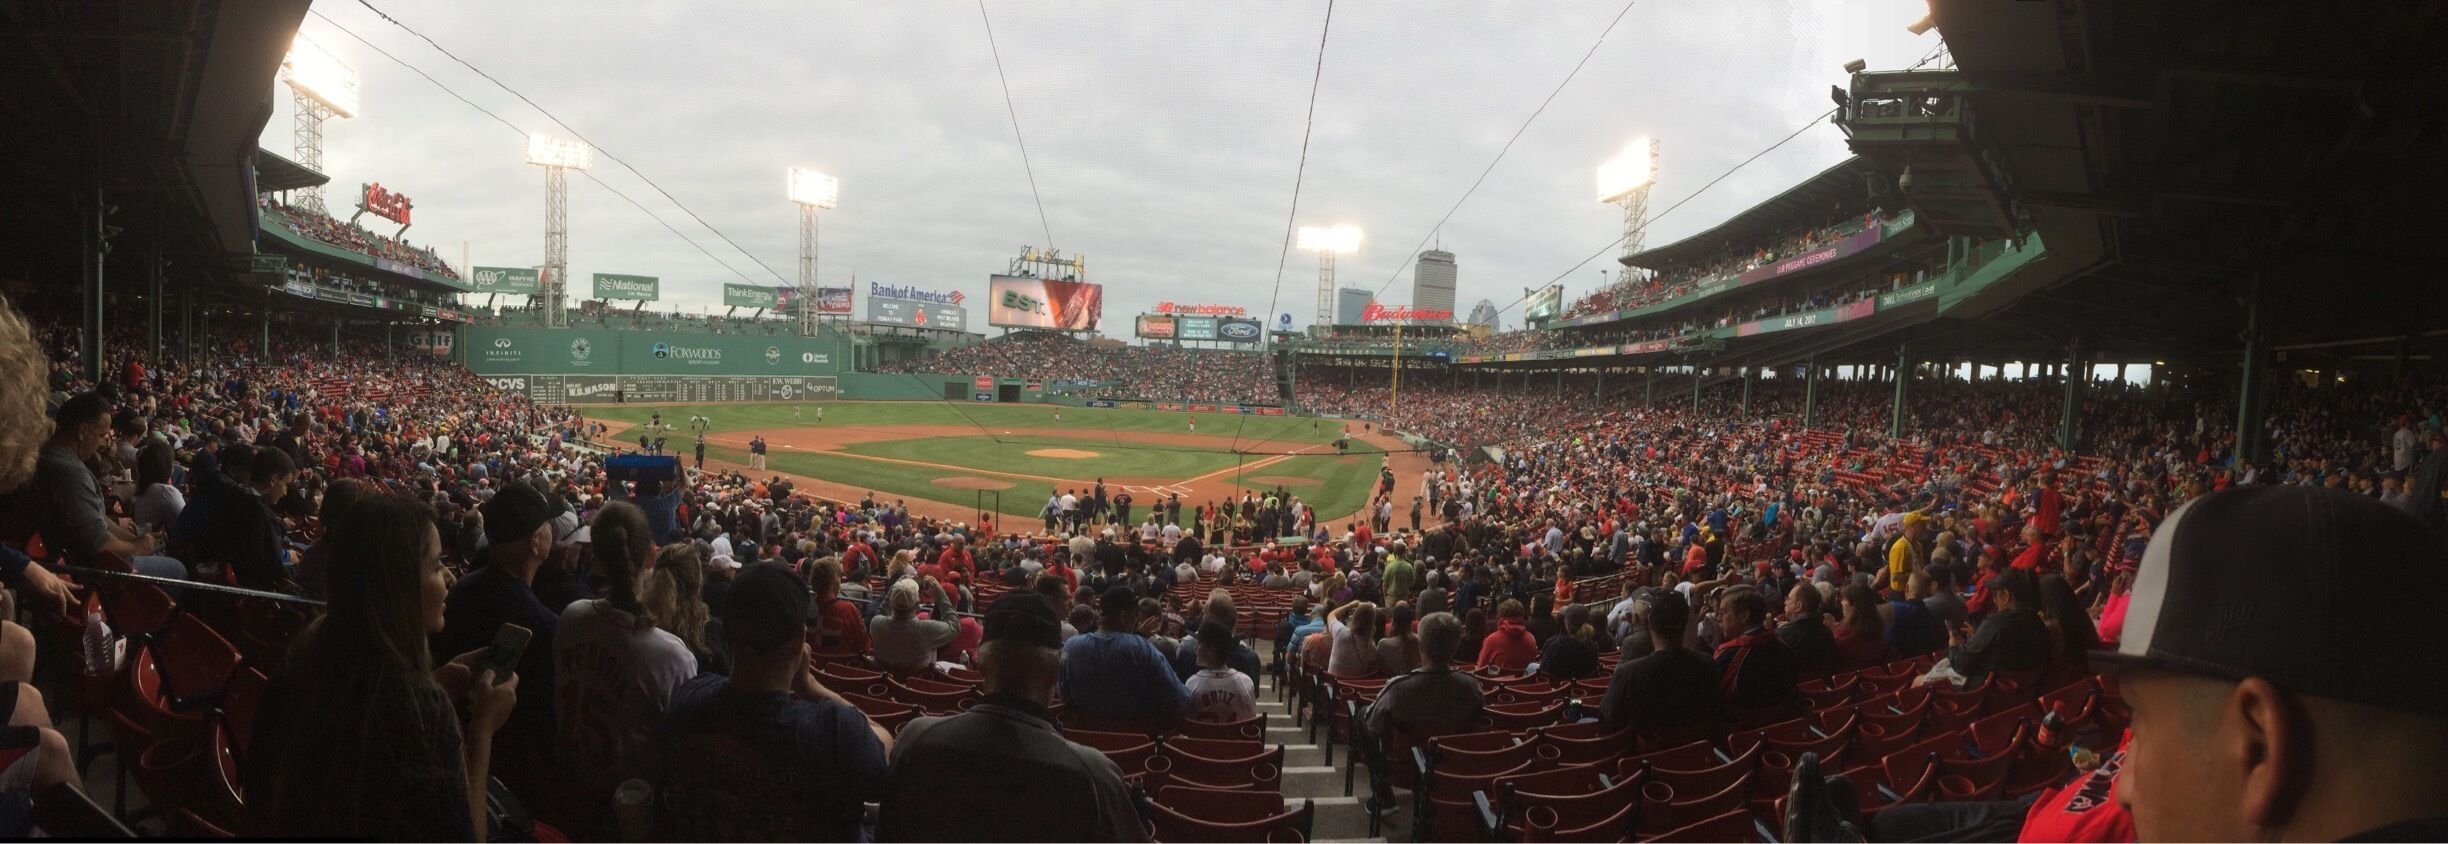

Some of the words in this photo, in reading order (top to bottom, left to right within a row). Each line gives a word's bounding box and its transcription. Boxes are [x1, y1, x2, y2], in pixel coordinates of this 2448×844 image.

[1776, 264, 1786, 274] OUR
[1785, 258, 1806, 272] PREGAME
[1806, 248, 1837, 265] CEREMONIES
[612, 279, 654, 292] National
[871, 281, 897, 299] Bank
[897, 284, 909, 299] of
[909, 286, 948, 304] America
[1174, 304, 1198, 314] new
[1198, 303, 1245, 316] balance
[1784, 316, 1796, 328] JULY
[1804, 314, 1816, 325] 2017
[1229, 326, 1250, 336] Ford
[410, 333, 451, 347] Gulf
[670, 345, 721, 359] FOXWOODS
[498, 378, 526, 390] CVS
[814, 385, 835, 393] OPTUM
[1201, 690, 1235, 708] ORTIZ
